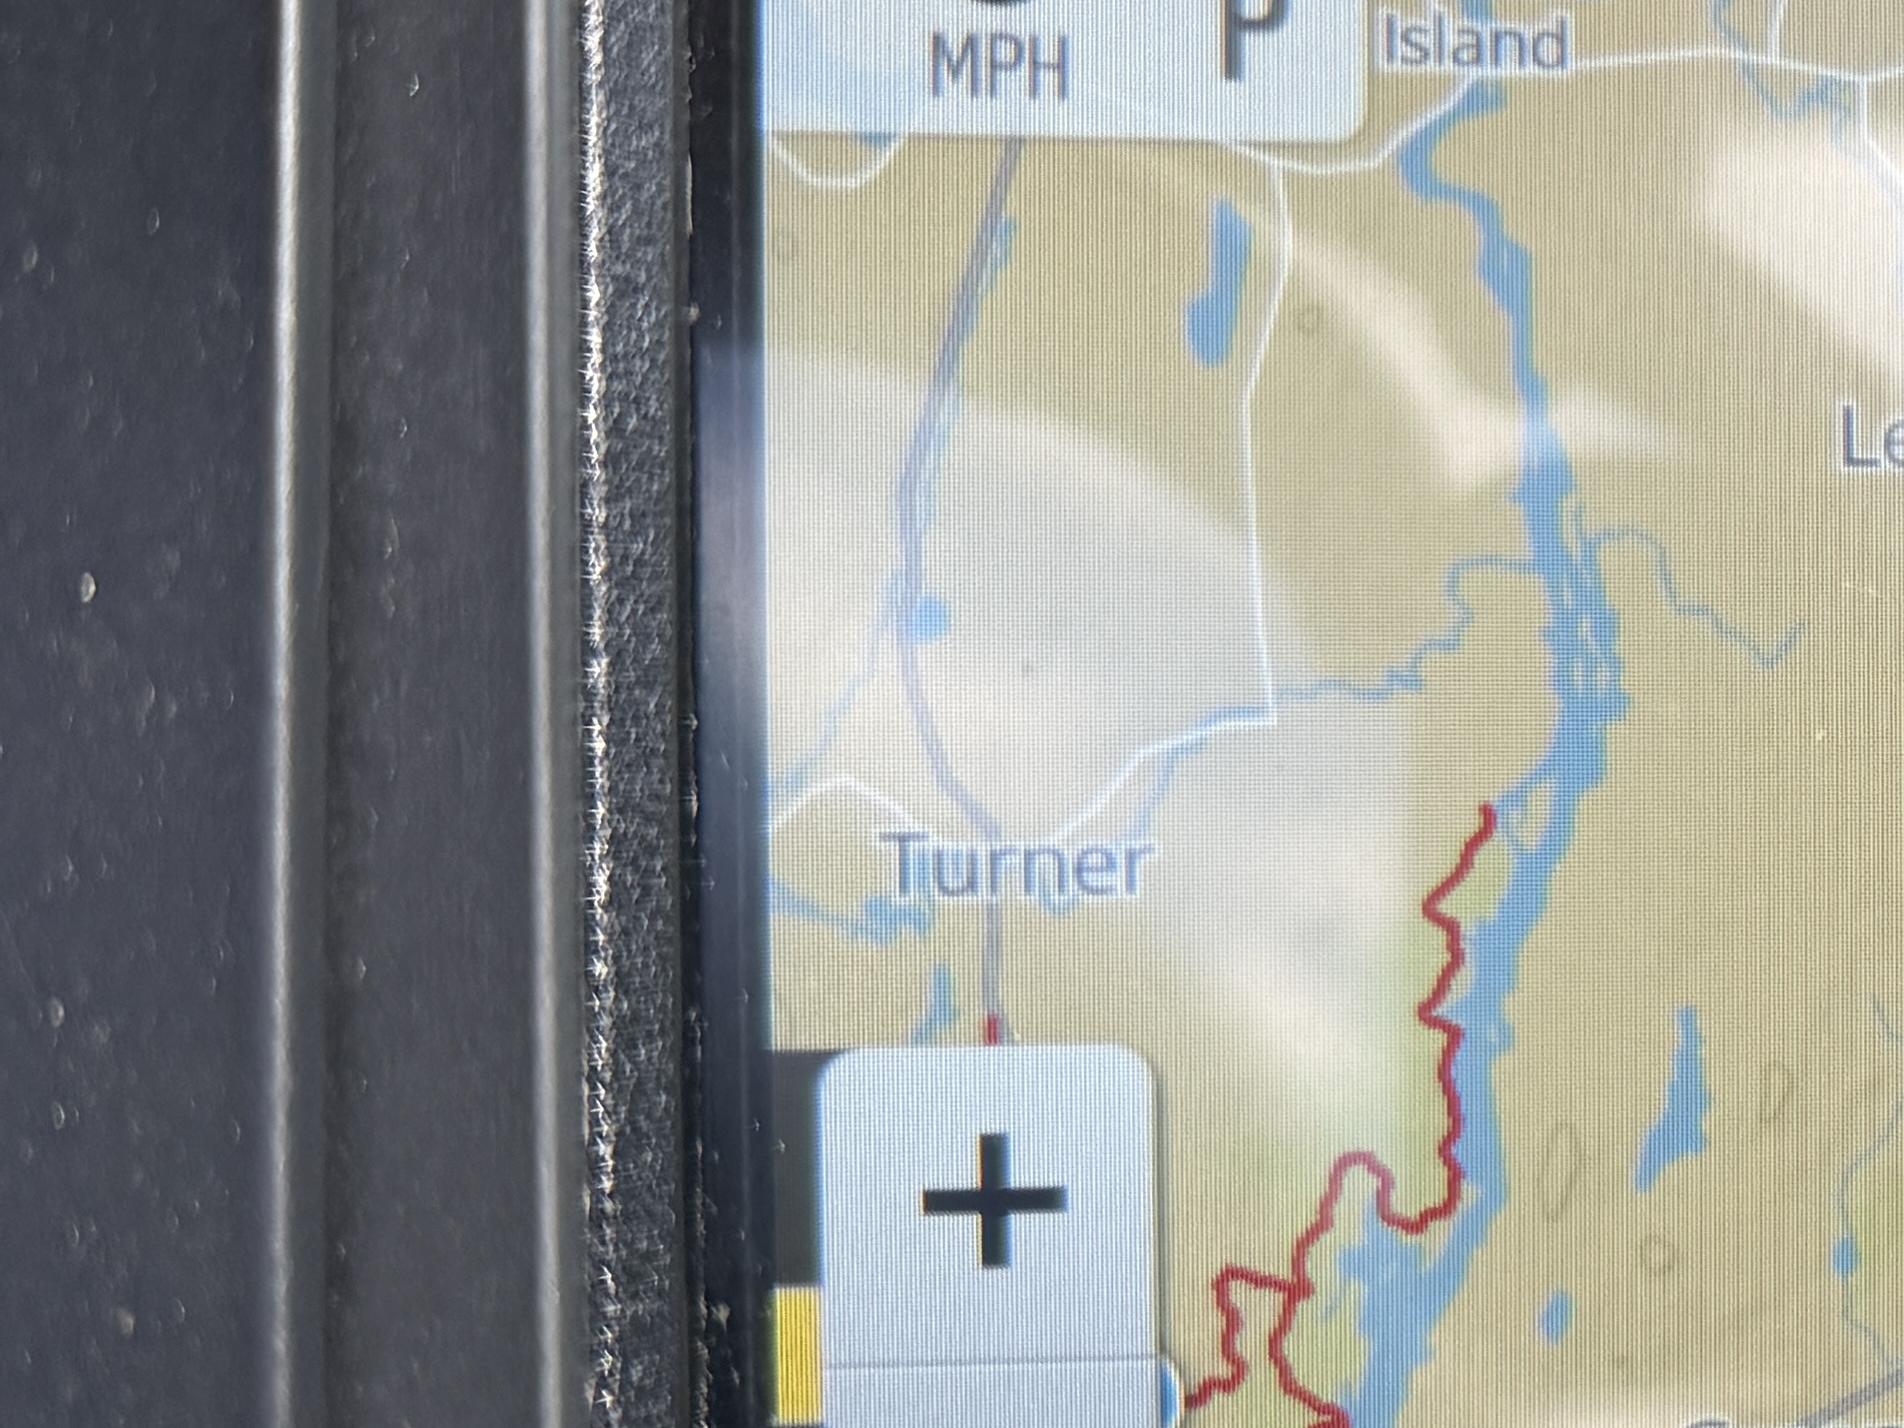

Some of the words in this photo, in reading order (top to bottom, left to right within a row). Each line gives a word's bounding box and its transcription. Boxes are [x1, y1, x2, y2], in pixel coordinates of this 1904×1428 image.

[931, 31, 1069, 101] MPH
[1386, 12, 1570, 71] Island
[879, 830, 1156, 898] Turner
